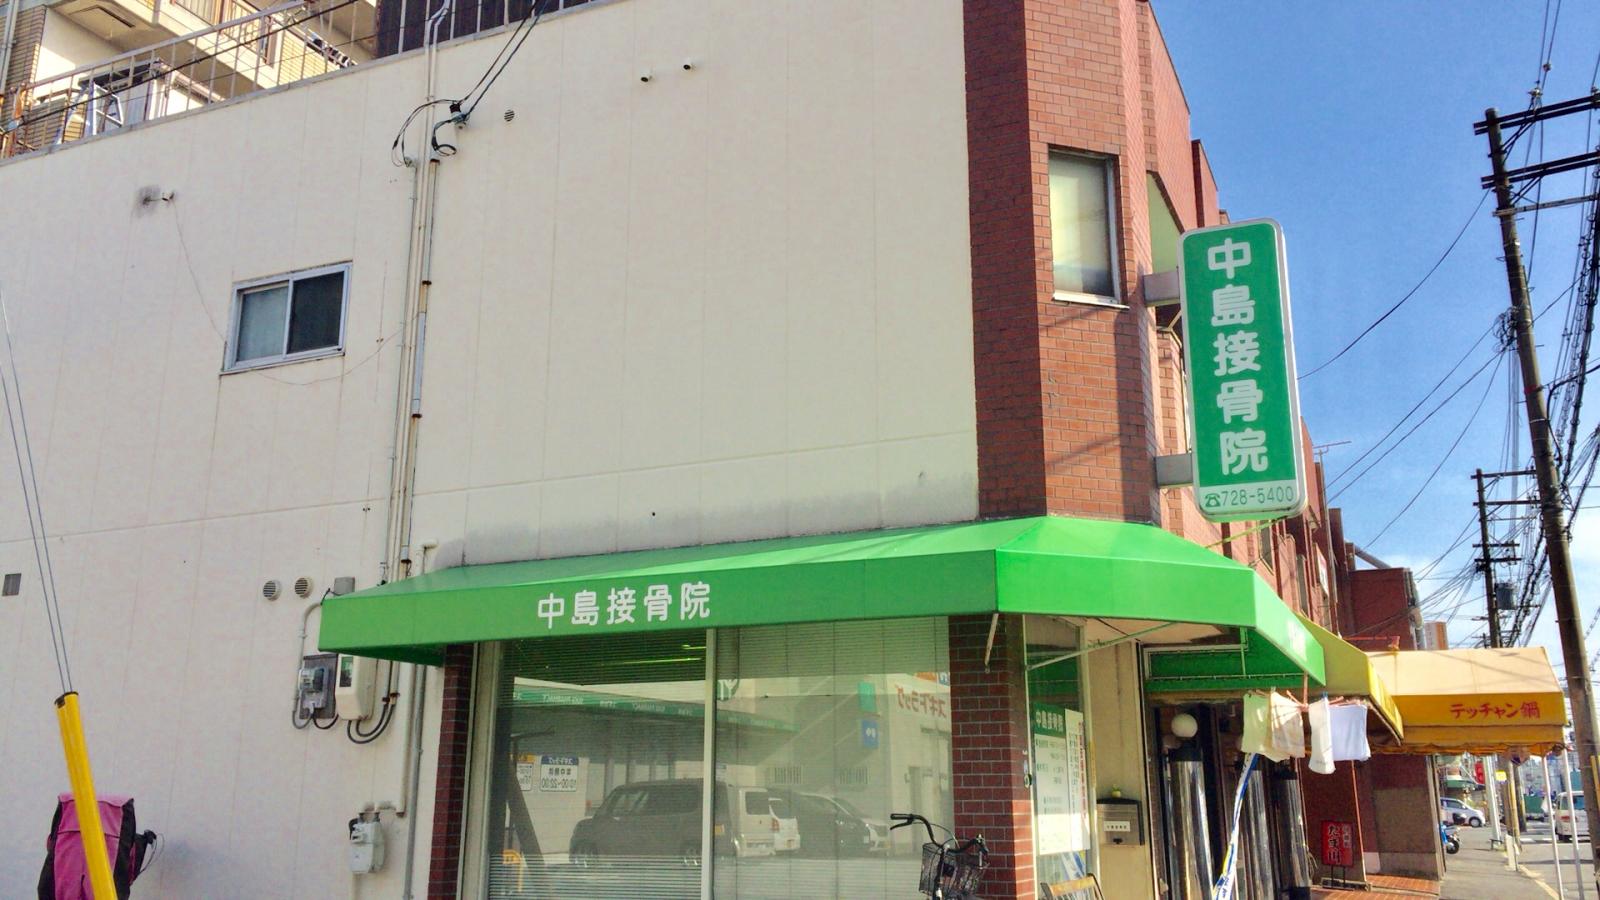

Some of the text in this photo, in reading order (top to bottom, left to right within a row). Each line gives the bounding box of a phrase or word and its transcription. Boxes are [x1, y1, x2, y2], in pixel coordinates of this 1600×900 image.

[1207, 237, 1269, 476] 中島接骨院
[1220, 485, 1295, 507] 728-5400
[537, 581, 711, 630] 中島接骨院
[1449, 700, 1541, 719] テッチャン鍋
